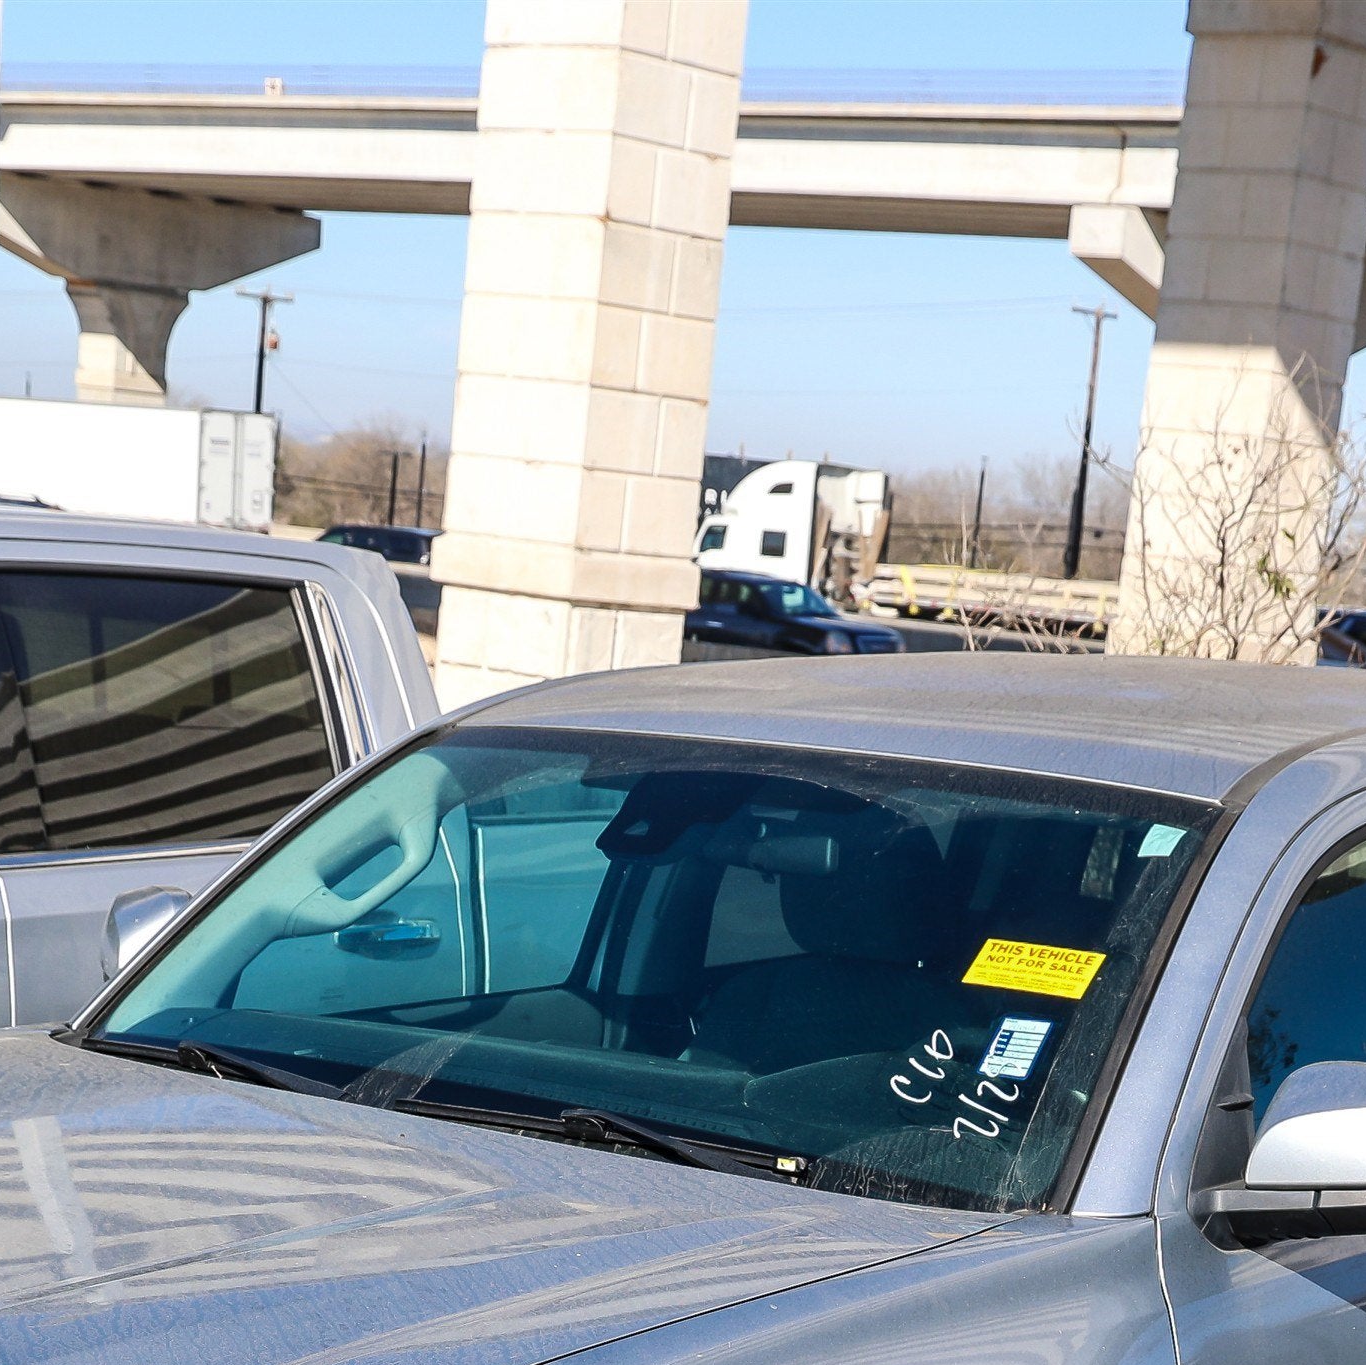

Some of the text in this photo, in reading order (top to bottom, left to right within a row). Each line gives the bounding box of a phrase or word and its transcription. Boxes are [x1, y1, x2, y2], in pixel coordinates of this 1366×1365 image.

[986, 954, 1086, 975] NOT FOR SALE
[990, 942, 1097, 966] THIS VEHICLE
